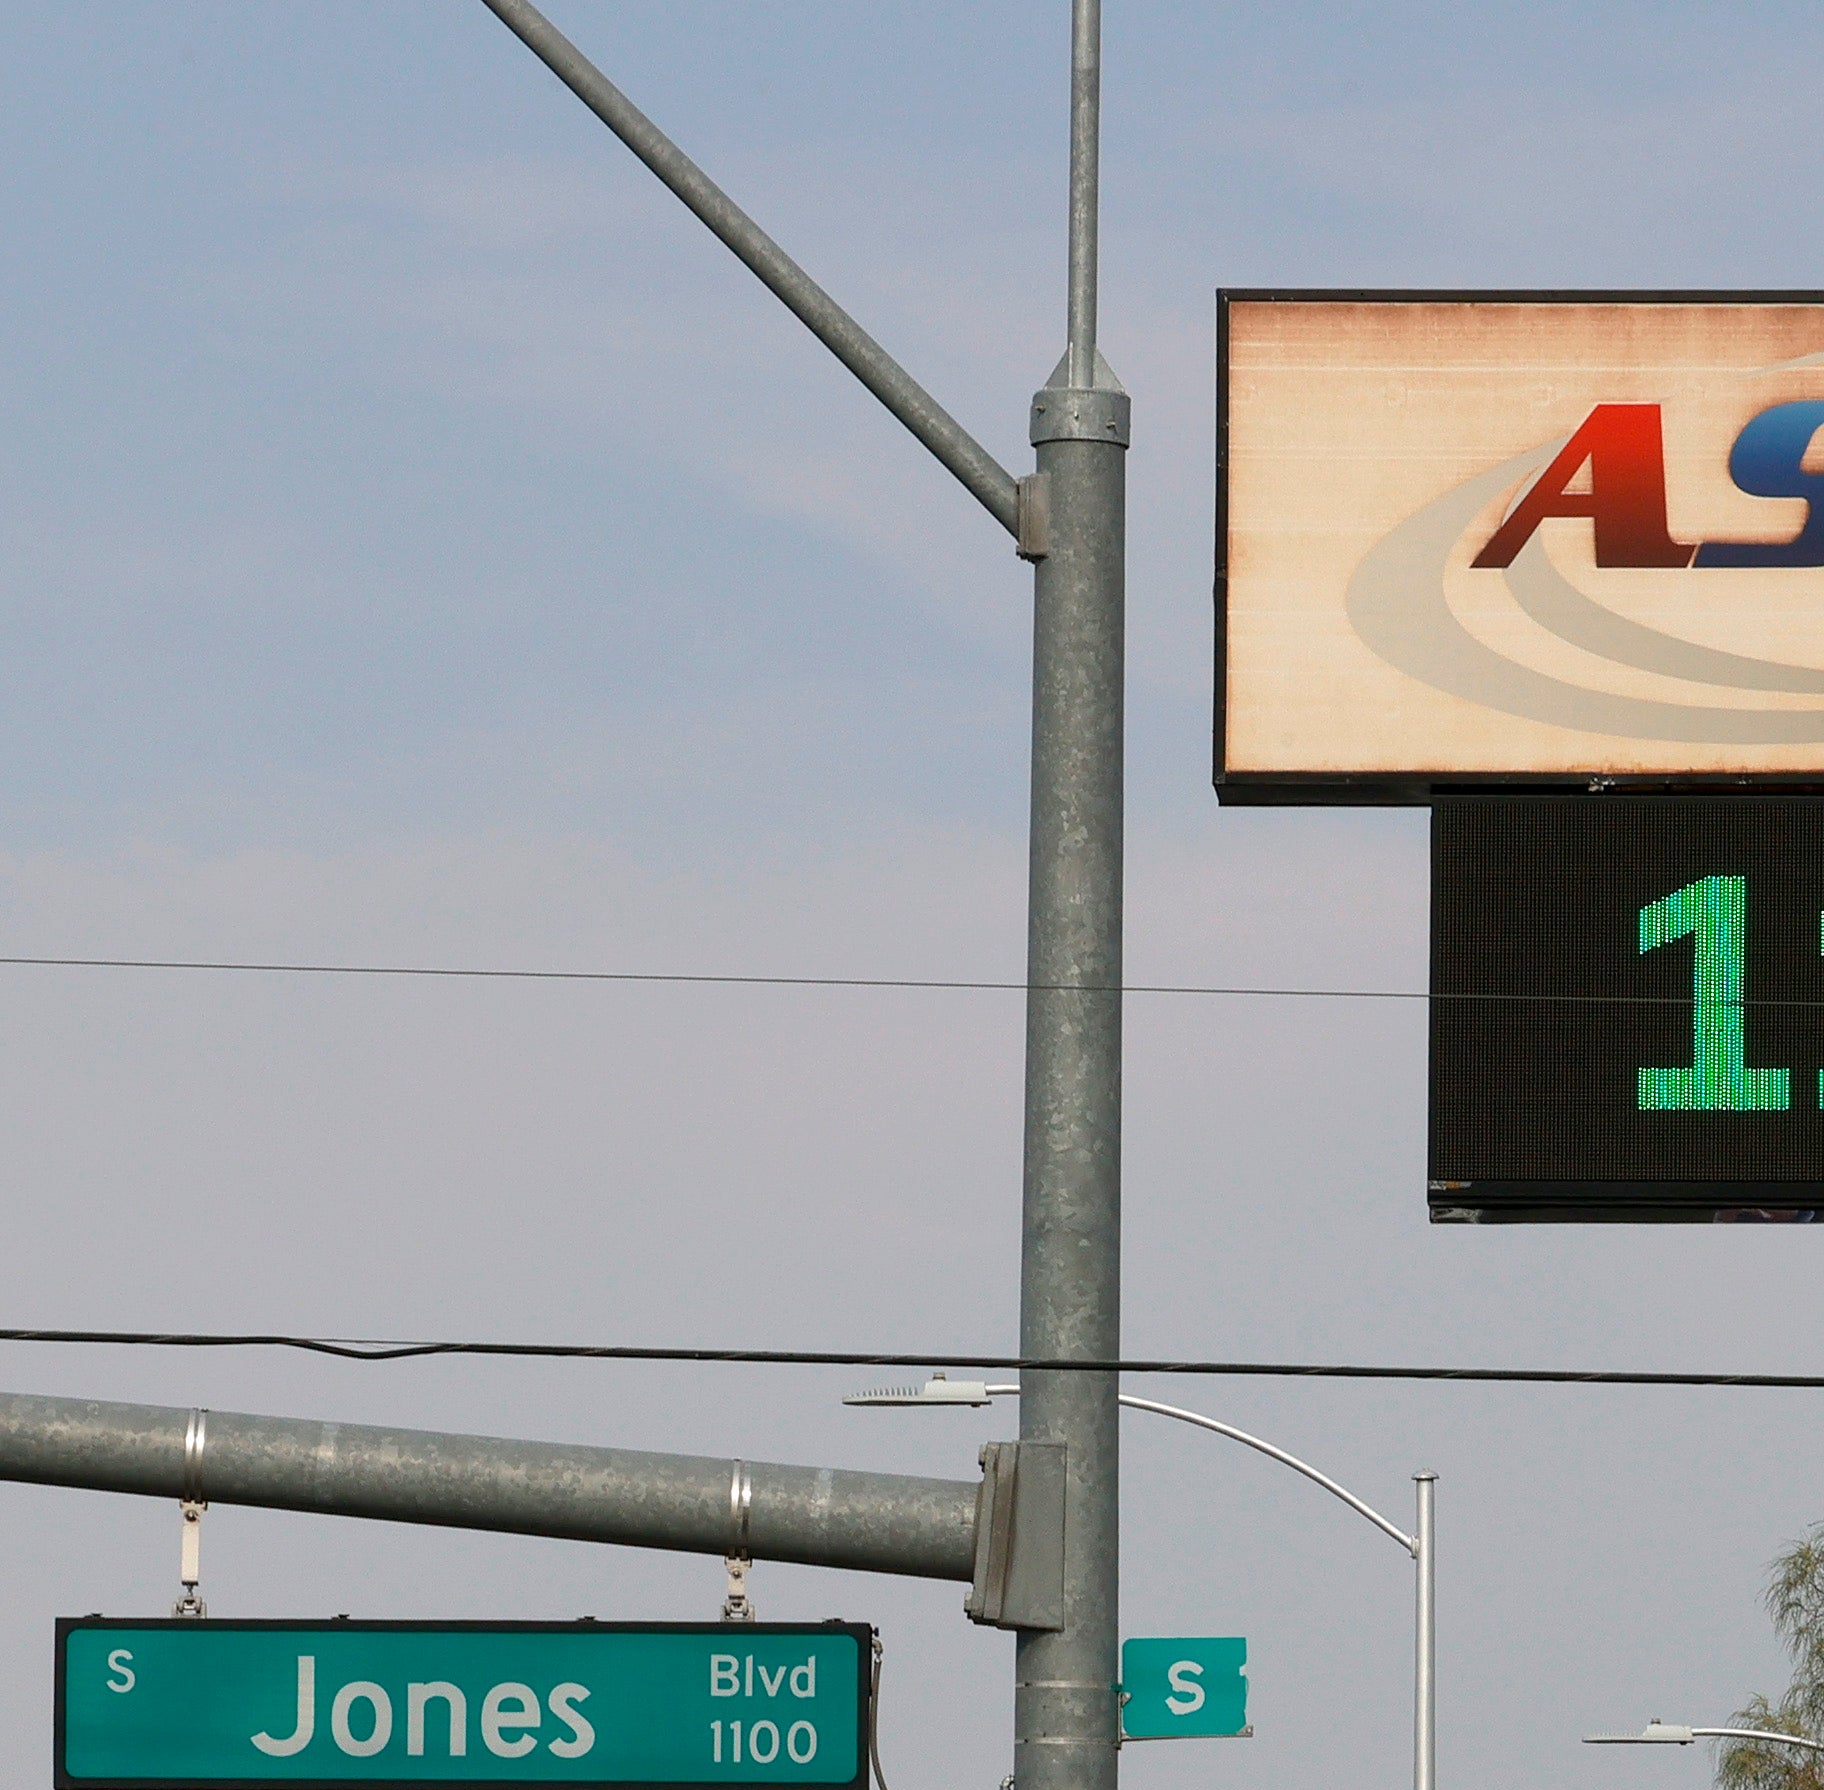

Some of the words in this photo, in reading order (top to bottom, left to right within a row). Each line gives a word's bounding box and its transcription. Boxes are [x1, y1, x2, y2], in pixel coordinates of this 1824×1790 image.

[106, 1649, 136, 1694] S
[711, 1656, 816, 1699] Blvd
[1166, 1661, 1207, 1715] S
[251, 1655, 595, 1759] Jones
[710, 1720, 817, 1766] 1100
